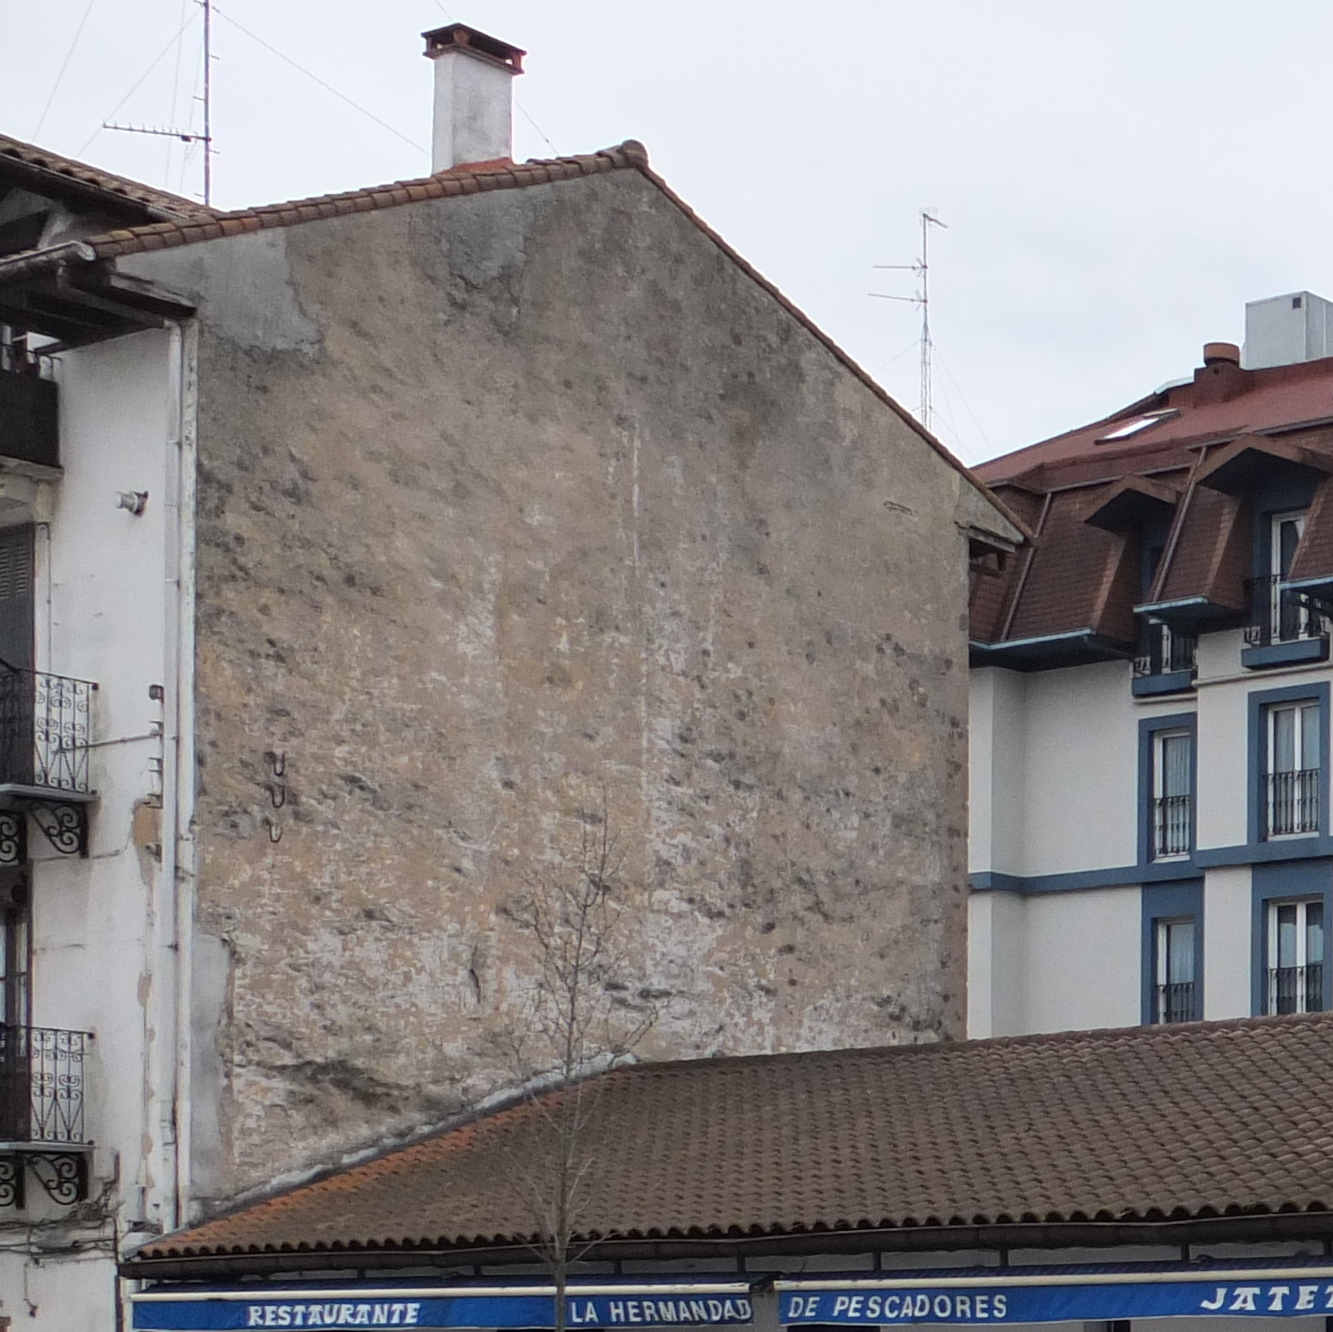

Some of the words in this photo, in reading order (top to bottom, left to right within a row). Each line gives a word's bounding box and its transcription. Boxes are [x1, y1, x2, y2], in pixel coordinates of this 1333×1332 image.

[247, 1302, 420, 1326] RESTAURANTE
[571, 1301, 599, 1323] LA
[609, 1299, 752, 1323] HERMANDAD
[788, 1296, 820, 1318] DE
[832, 1294, 1007, 1319] PESCADORES
